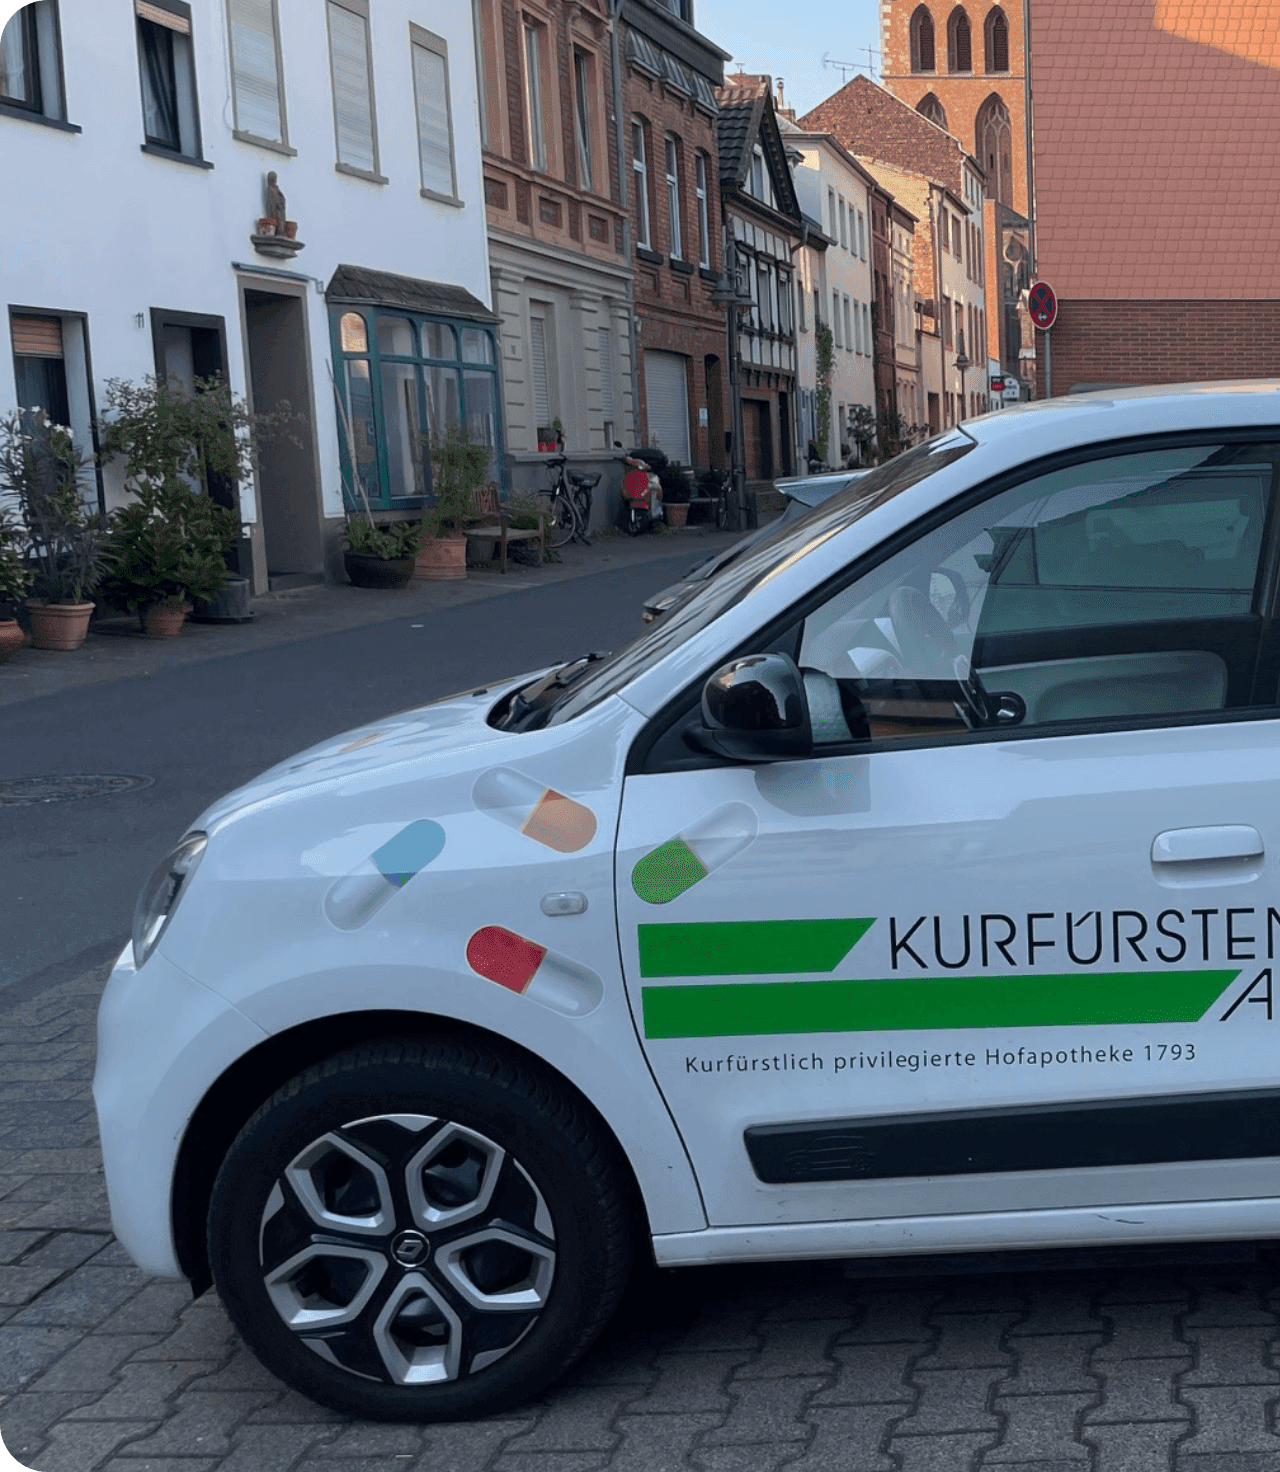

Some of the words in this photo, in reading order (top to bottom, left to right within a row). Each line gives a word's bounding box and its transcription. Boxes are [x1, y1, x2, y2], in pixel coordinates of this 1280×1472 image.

[685, 1051, 824, 1073] Kurfürstlich
[834, 1048, 976, 1074] privilegierte
[985, 1043, 1134, 1068] Hofapotheke
[1143, 1043, 1197, 1062] 1793
